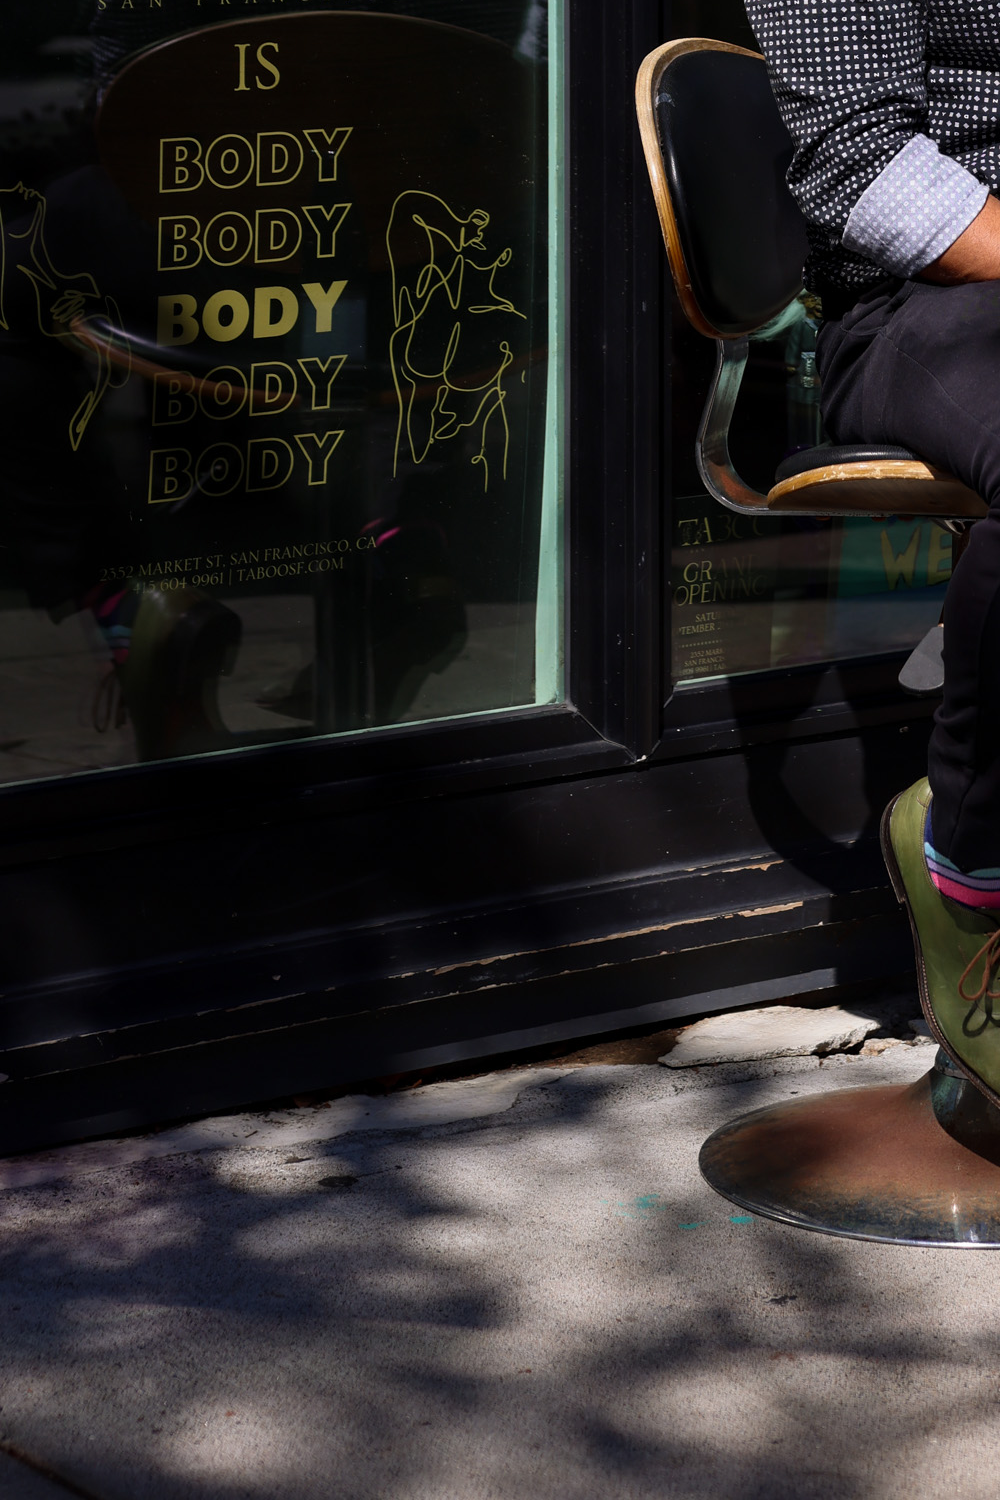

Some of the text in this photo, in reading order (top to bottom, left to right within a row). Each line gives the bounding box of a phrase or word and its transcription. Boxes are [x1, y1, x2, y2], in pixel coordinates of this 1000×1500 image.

[233, 41, 282, 92] IS
[159, 126, 353, 193] BODY
[157, 202, 352, 272] BODY
[156, 280, 348, 348] BODY
[152, 355, 348, 426] BODY
[148, 429, 346, 504] BODY
[132, 557, 344, 595] 415 604 9961 TABOOSF.COM
[138, 556, 202, 577] MARKET
[230, 549, 260, 566] SAN
[356, 536, 377, 550] CA
